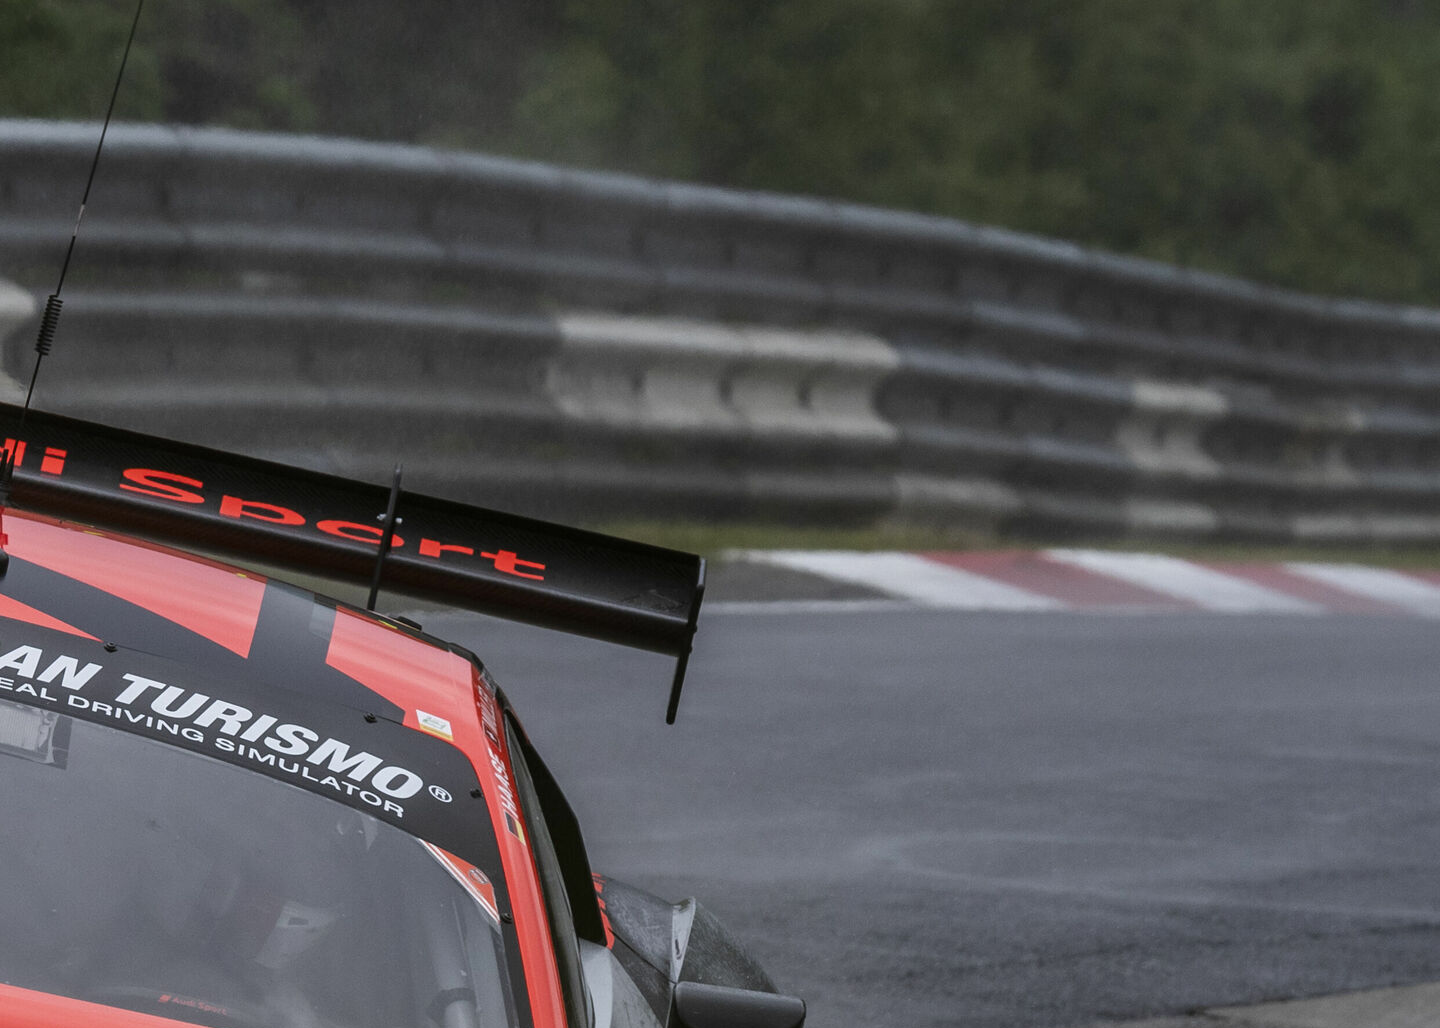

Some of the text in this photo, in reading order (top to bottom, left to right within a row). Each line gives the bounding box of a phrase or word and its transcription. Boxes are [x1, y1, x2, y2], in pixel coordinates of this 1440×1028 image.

[119, 467, 546, 581] Sport
[67, 695, 205, 744] DRIVING
[215, 738, 405, 819] SIMULATOR
[487, 747, 520, 820] HAASE
